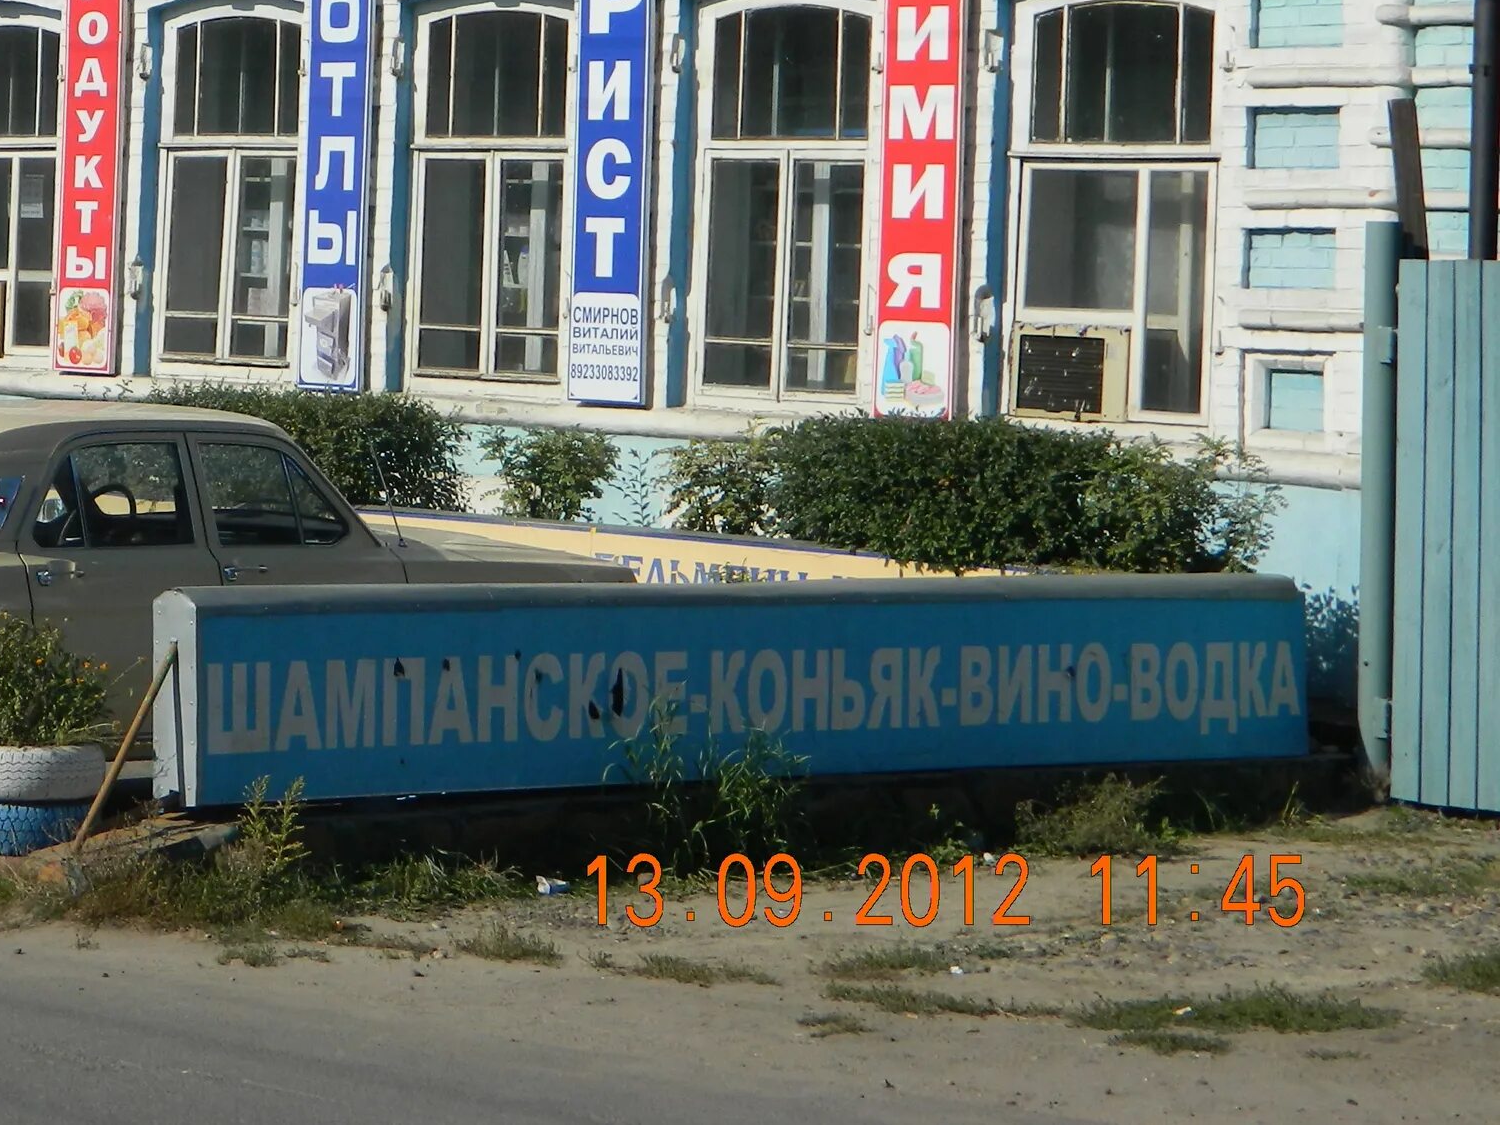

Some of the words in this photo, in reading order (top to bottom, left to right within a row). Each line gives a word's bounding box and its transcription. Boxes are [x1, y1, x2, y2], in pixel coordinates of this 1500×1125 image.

[573, 306, 639, 325] СМИРНОВ
[573, 326, 639, 341] ВИТАЛИЙ
[572, 343, 639, 356] ВИТАЛЬЕВИЧ
[570, 363, 639, 382] 89233083392
